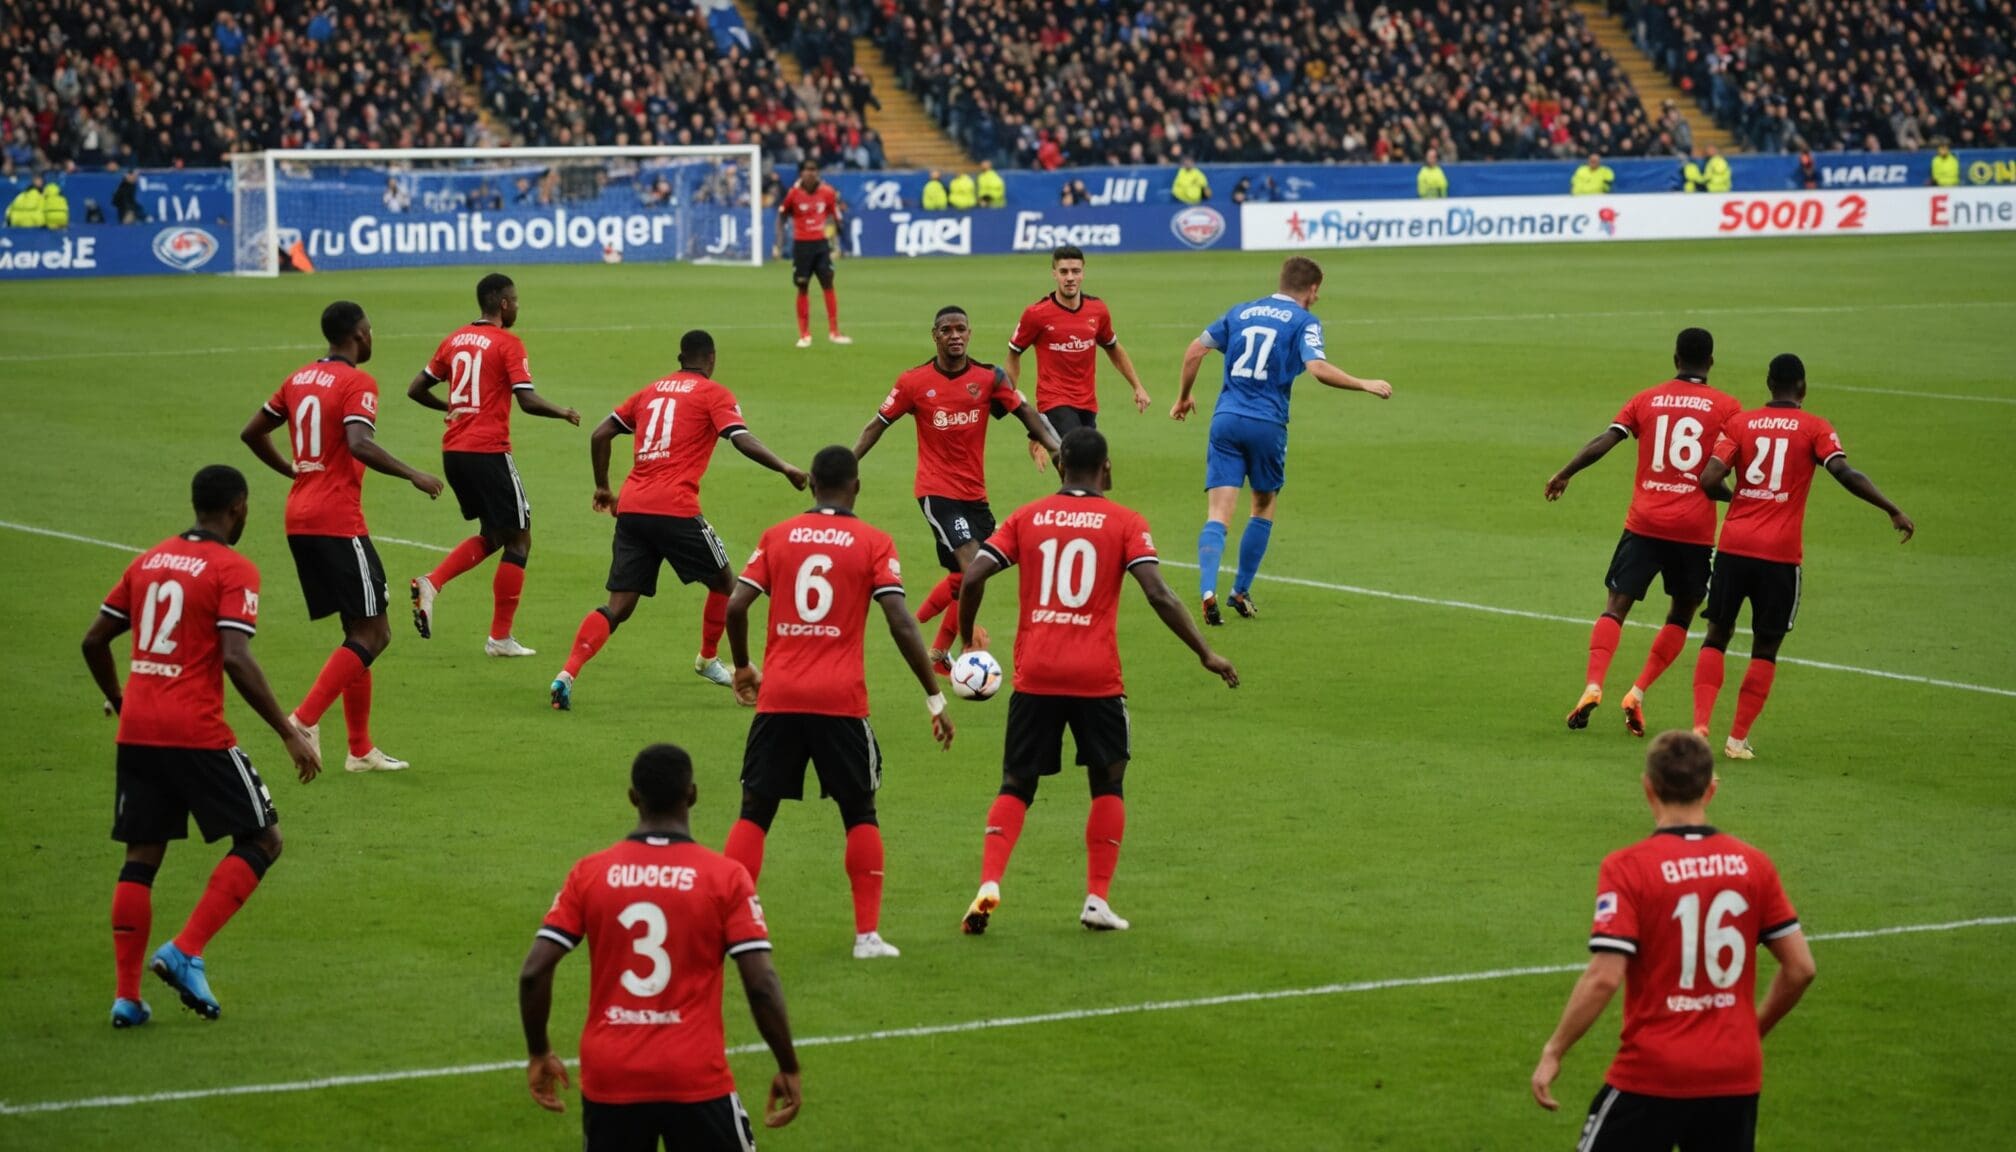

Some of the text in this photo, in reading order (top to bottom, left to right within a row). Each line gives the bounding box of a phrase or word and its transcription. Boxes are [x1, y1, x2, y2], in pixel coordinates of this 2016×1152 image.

[1837, 194, 1867, 229] 2
[451, 349, 482, 408] 21
[794, 553, 834, 624] 6
[1039, 537, 1098, 609] 10
[138, 579, 185, 655] 12
[616, 901, 672, 997] 3
[1671, 888, 1750, 990] 16
